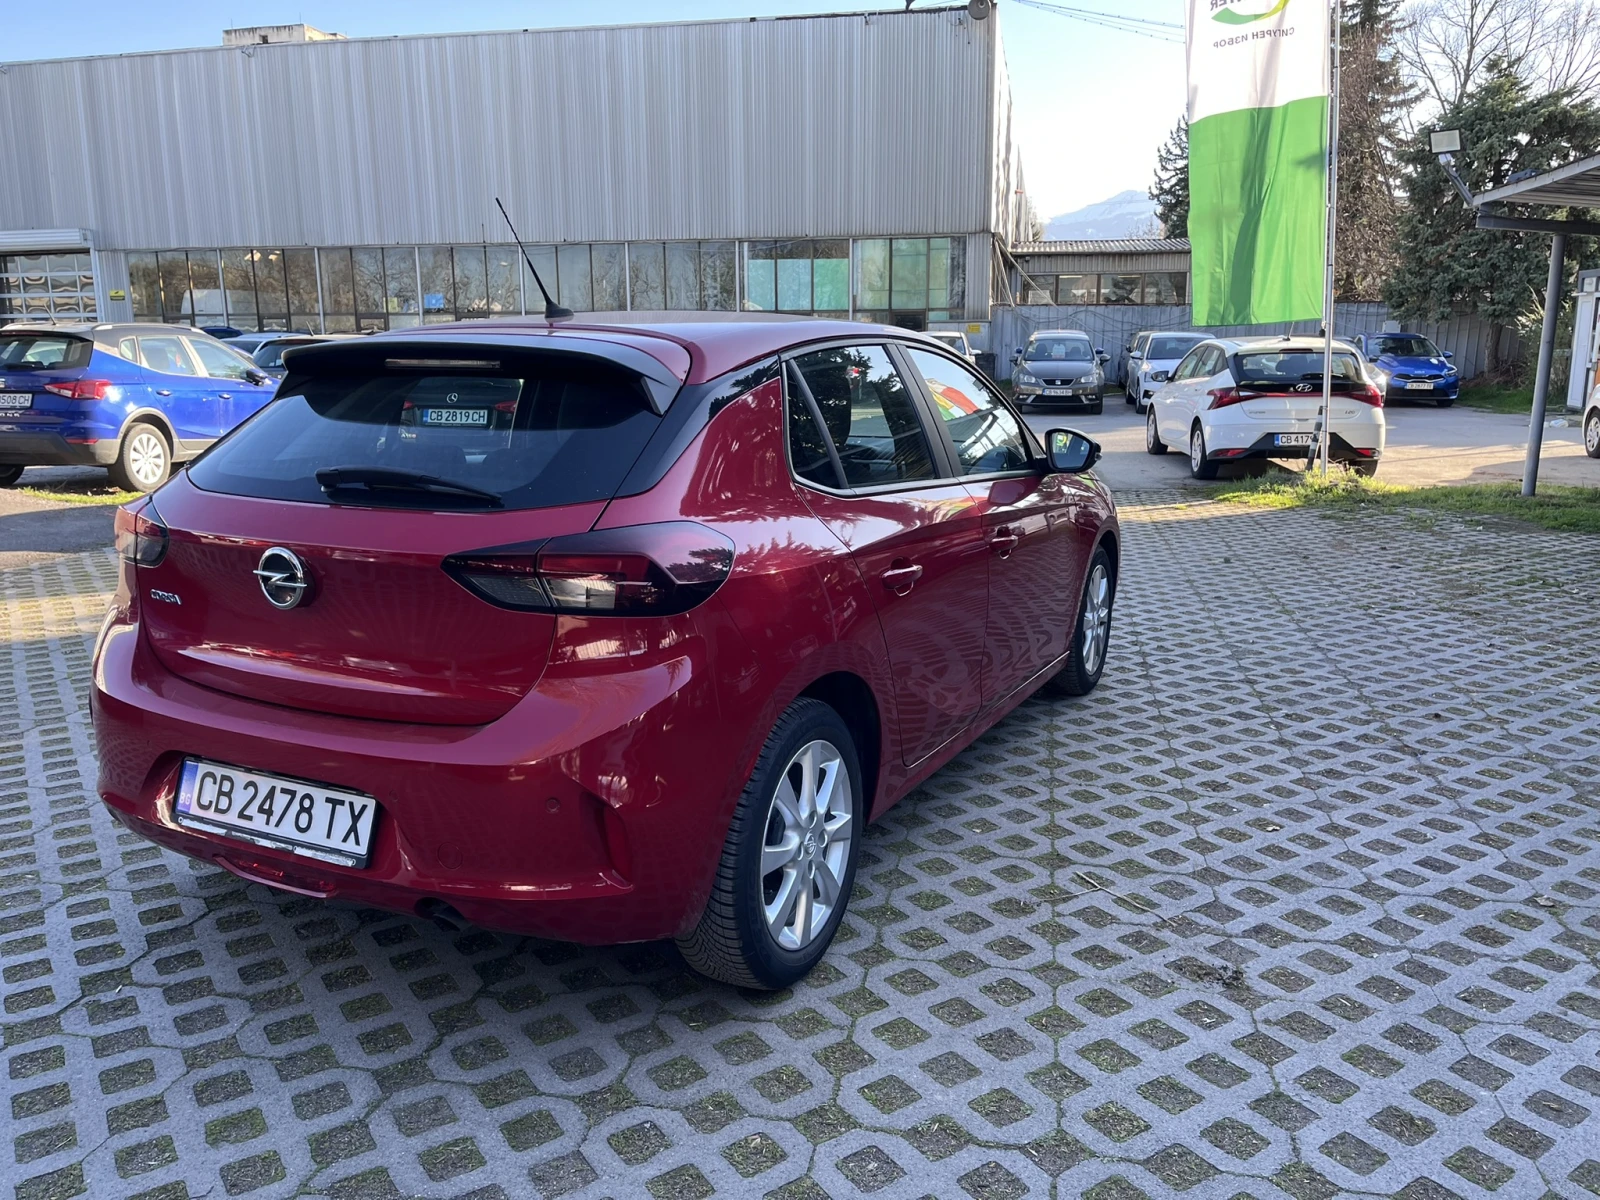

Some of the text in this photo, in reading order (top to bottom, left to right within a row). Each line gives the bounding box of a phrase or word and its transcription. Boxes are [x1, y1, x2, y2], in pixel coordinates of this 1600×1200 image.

[0, 395, 30, 405] 508 CH
[430, 410, 486, 422] CB 2819 CH
[1280, 435, 1292, 444] CB
[179, 793, 192, 805] BG
[196, 771, 368, 847] CB 2478 TX
